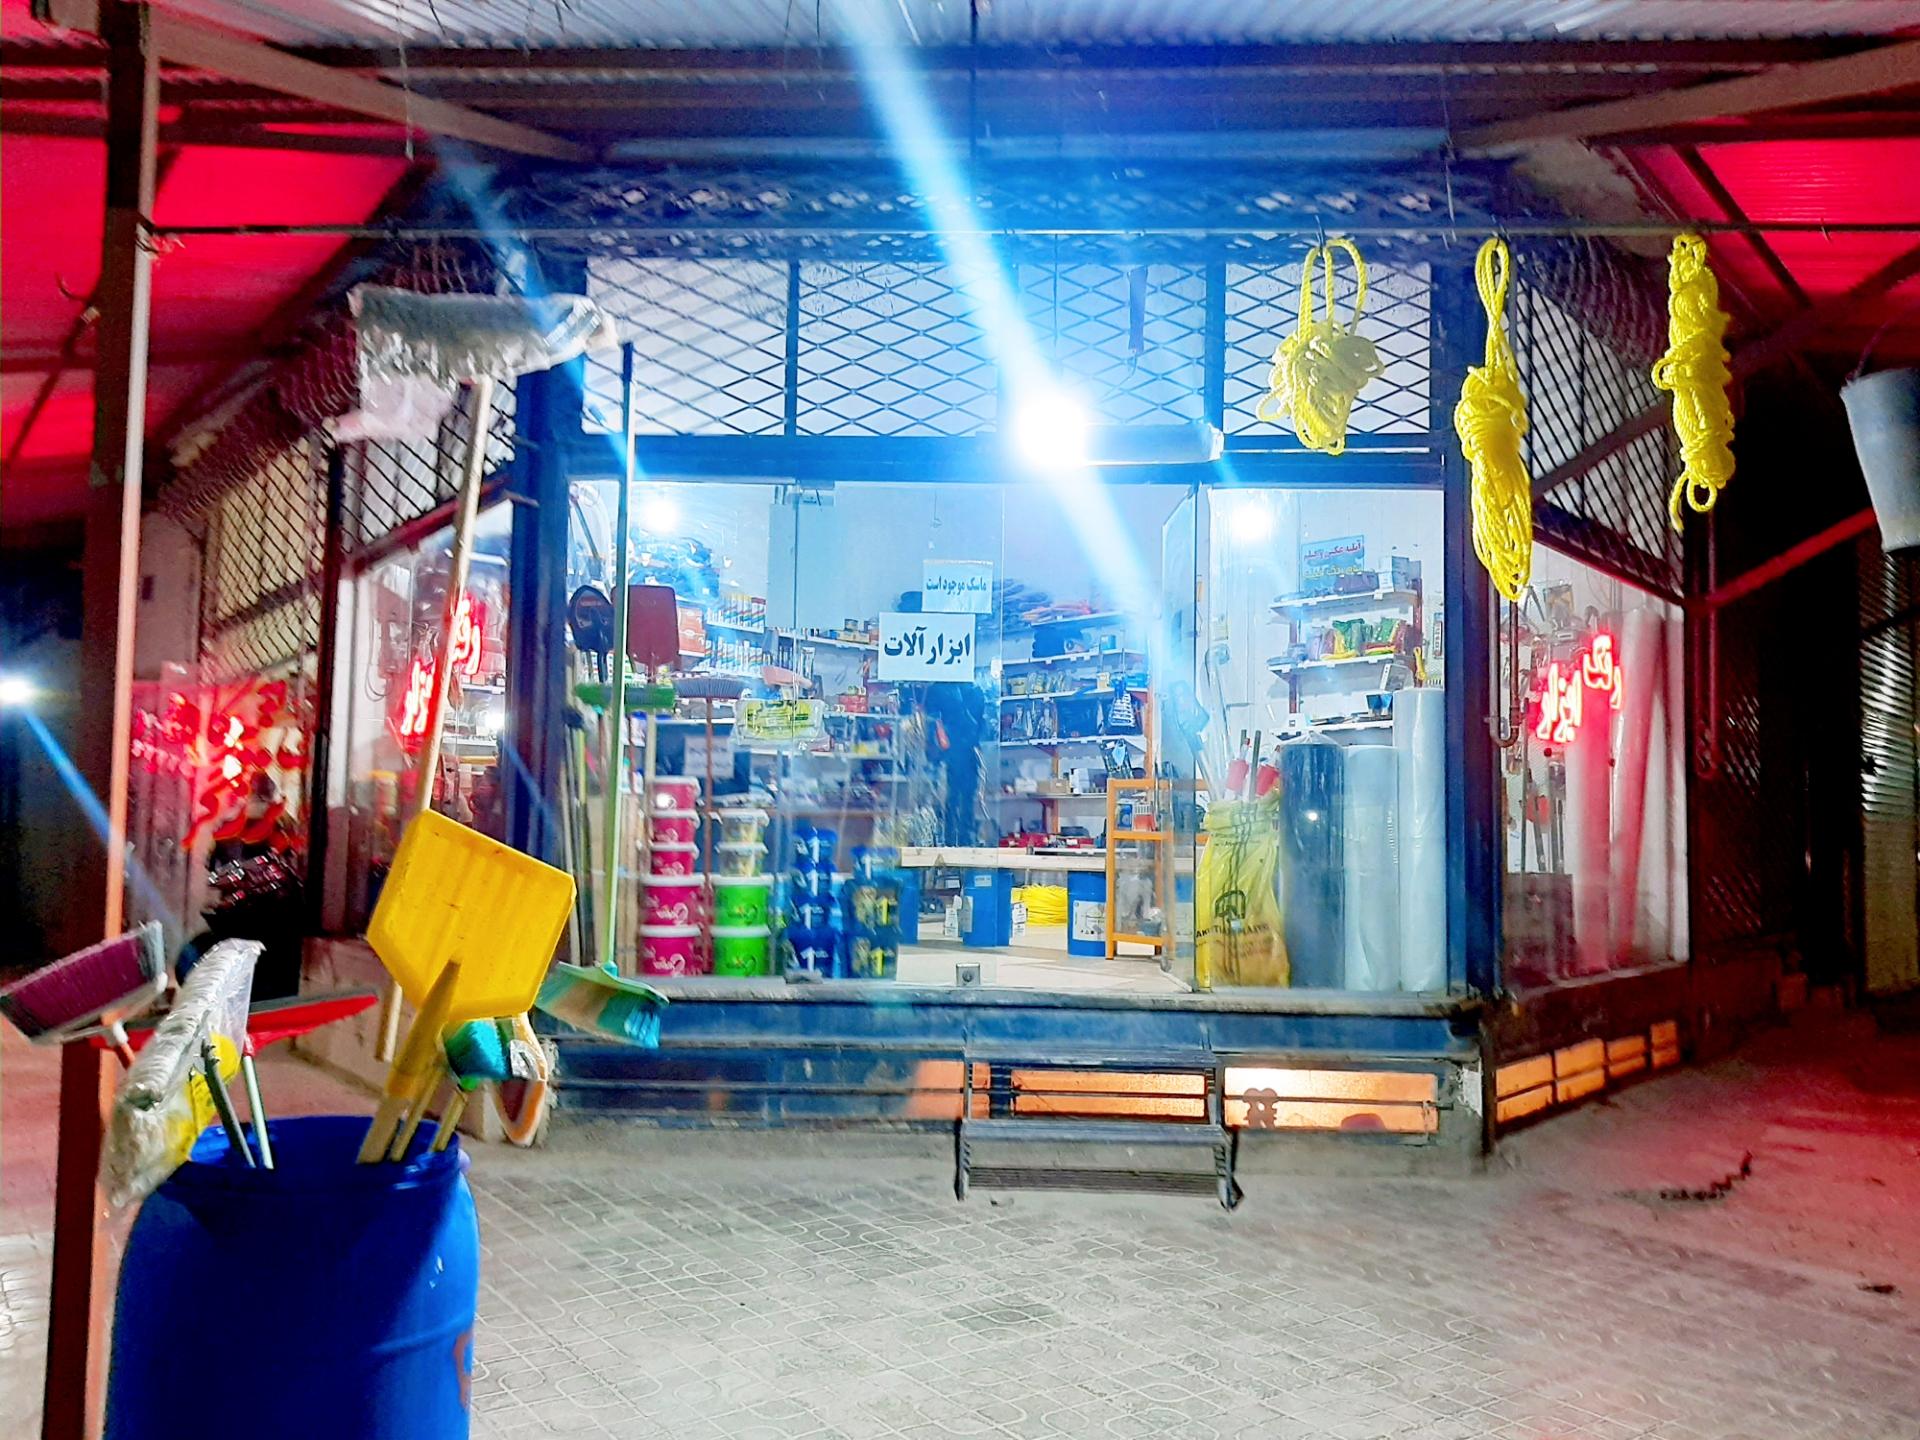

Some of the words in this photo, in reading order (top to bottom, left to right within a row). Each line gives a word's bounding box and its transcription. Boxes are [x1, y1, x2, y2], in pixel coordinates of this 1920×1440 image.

[926, 576, 941, 591] است
[943, 578, 965, 595] موجود
[966, 577, 986, 591] ماسک
[884, 626, 927, 656] آلات
[926, 632, 970, 664] ابزار
